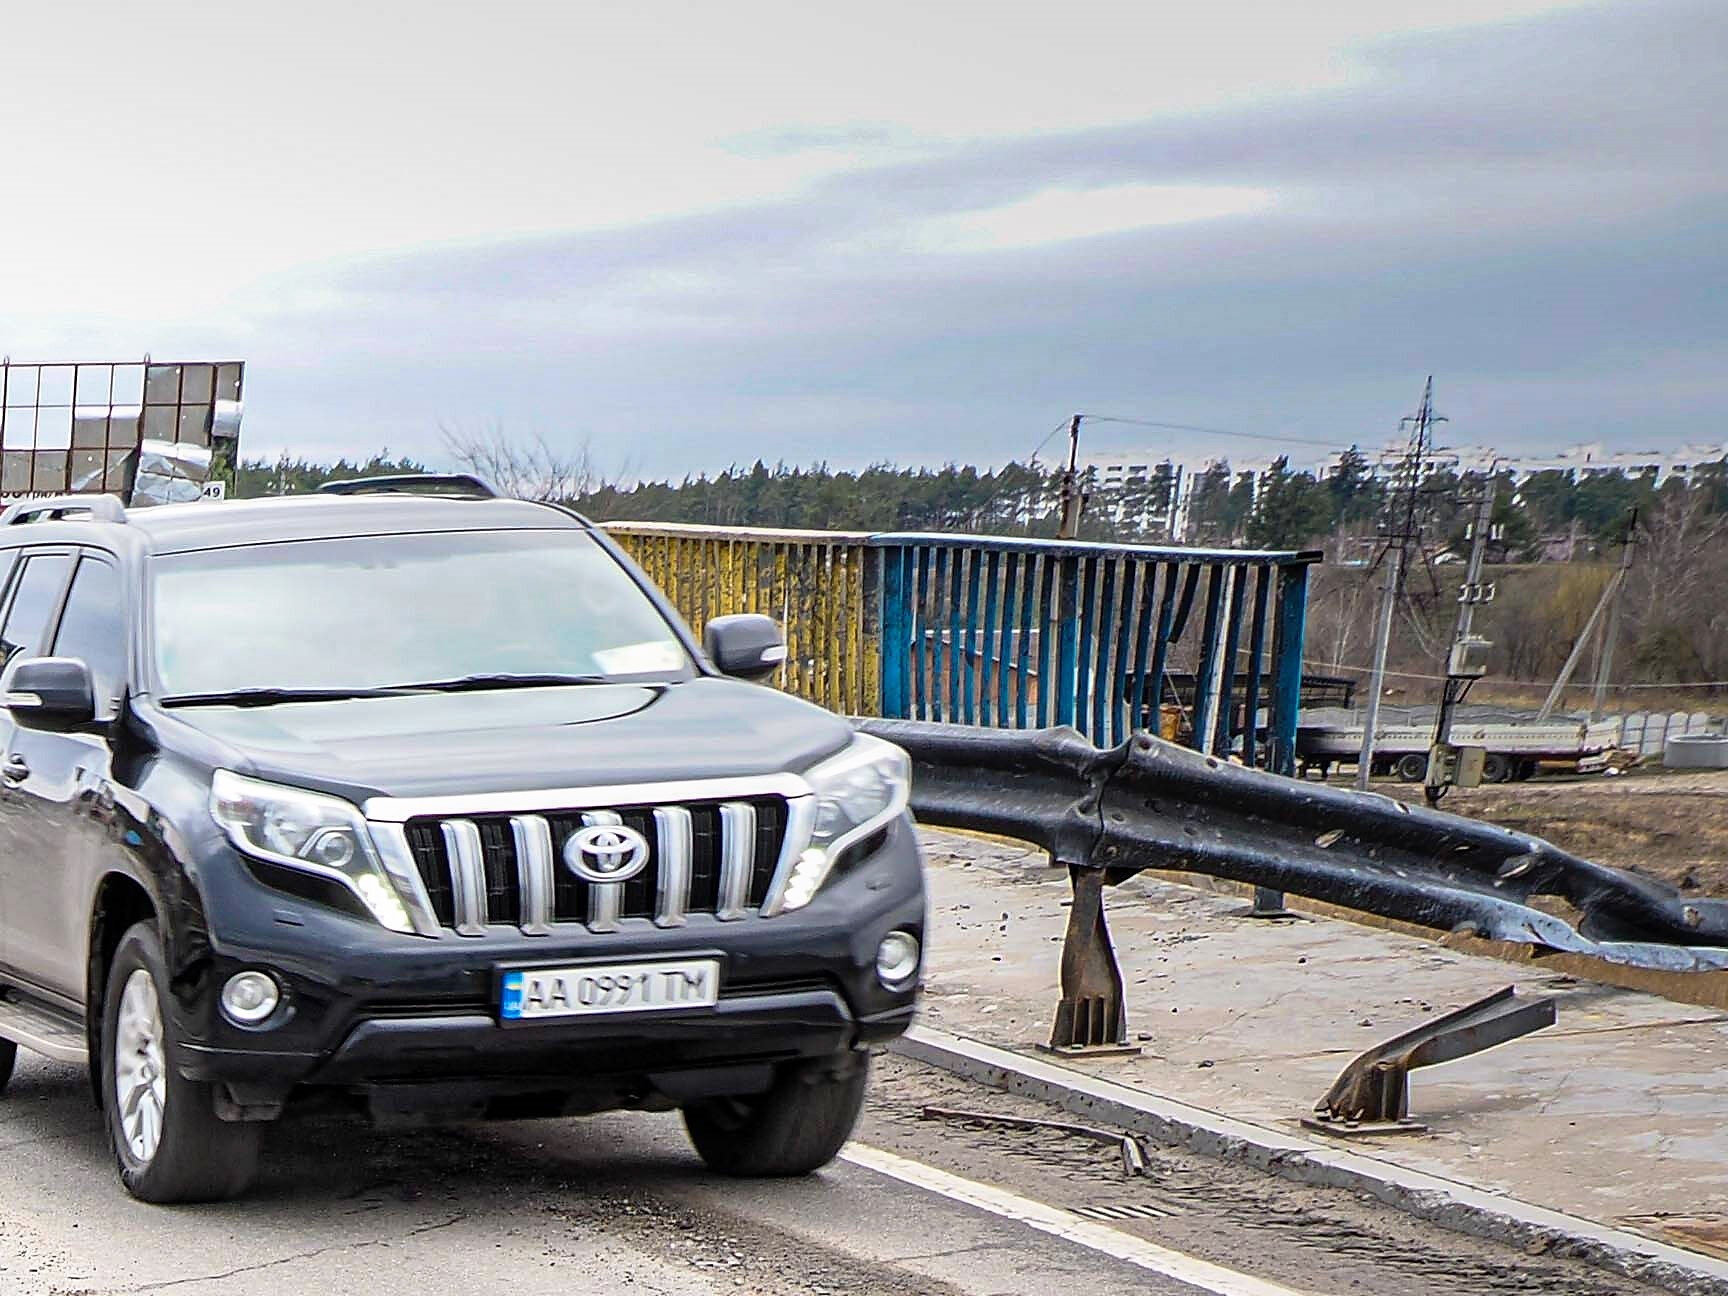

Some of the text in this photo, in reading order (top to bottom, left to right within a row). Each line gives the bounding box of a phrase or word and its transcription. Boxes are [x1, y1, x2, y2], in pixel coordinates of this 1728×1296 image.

[523, 969, 709, 1010] AA 0991 TM
